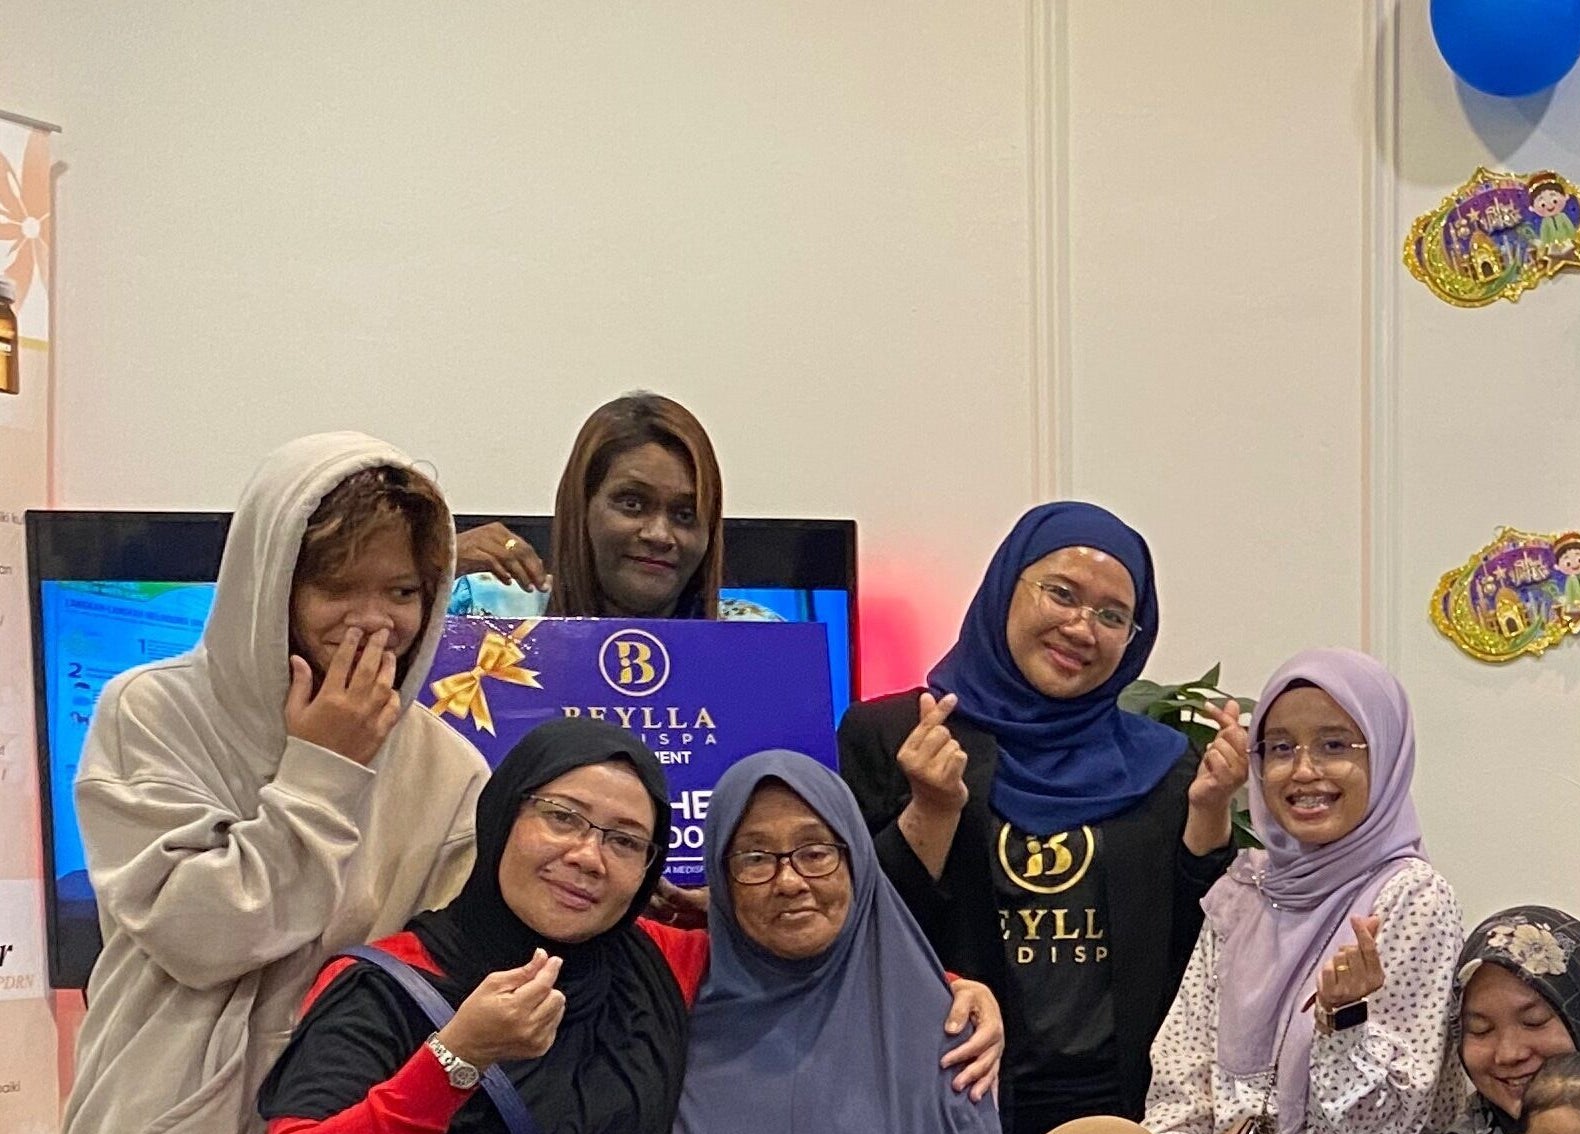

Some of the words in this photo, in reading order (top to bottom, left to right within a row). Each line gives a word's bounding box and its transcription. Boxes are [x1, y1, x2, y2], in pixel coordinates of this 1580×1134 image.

[68, 662, 83, 678] 2
[641, 733, 717, 745] ISPA
[670, 791, 714, 820] HE
[1017, 946, 1108, 964] DISP
